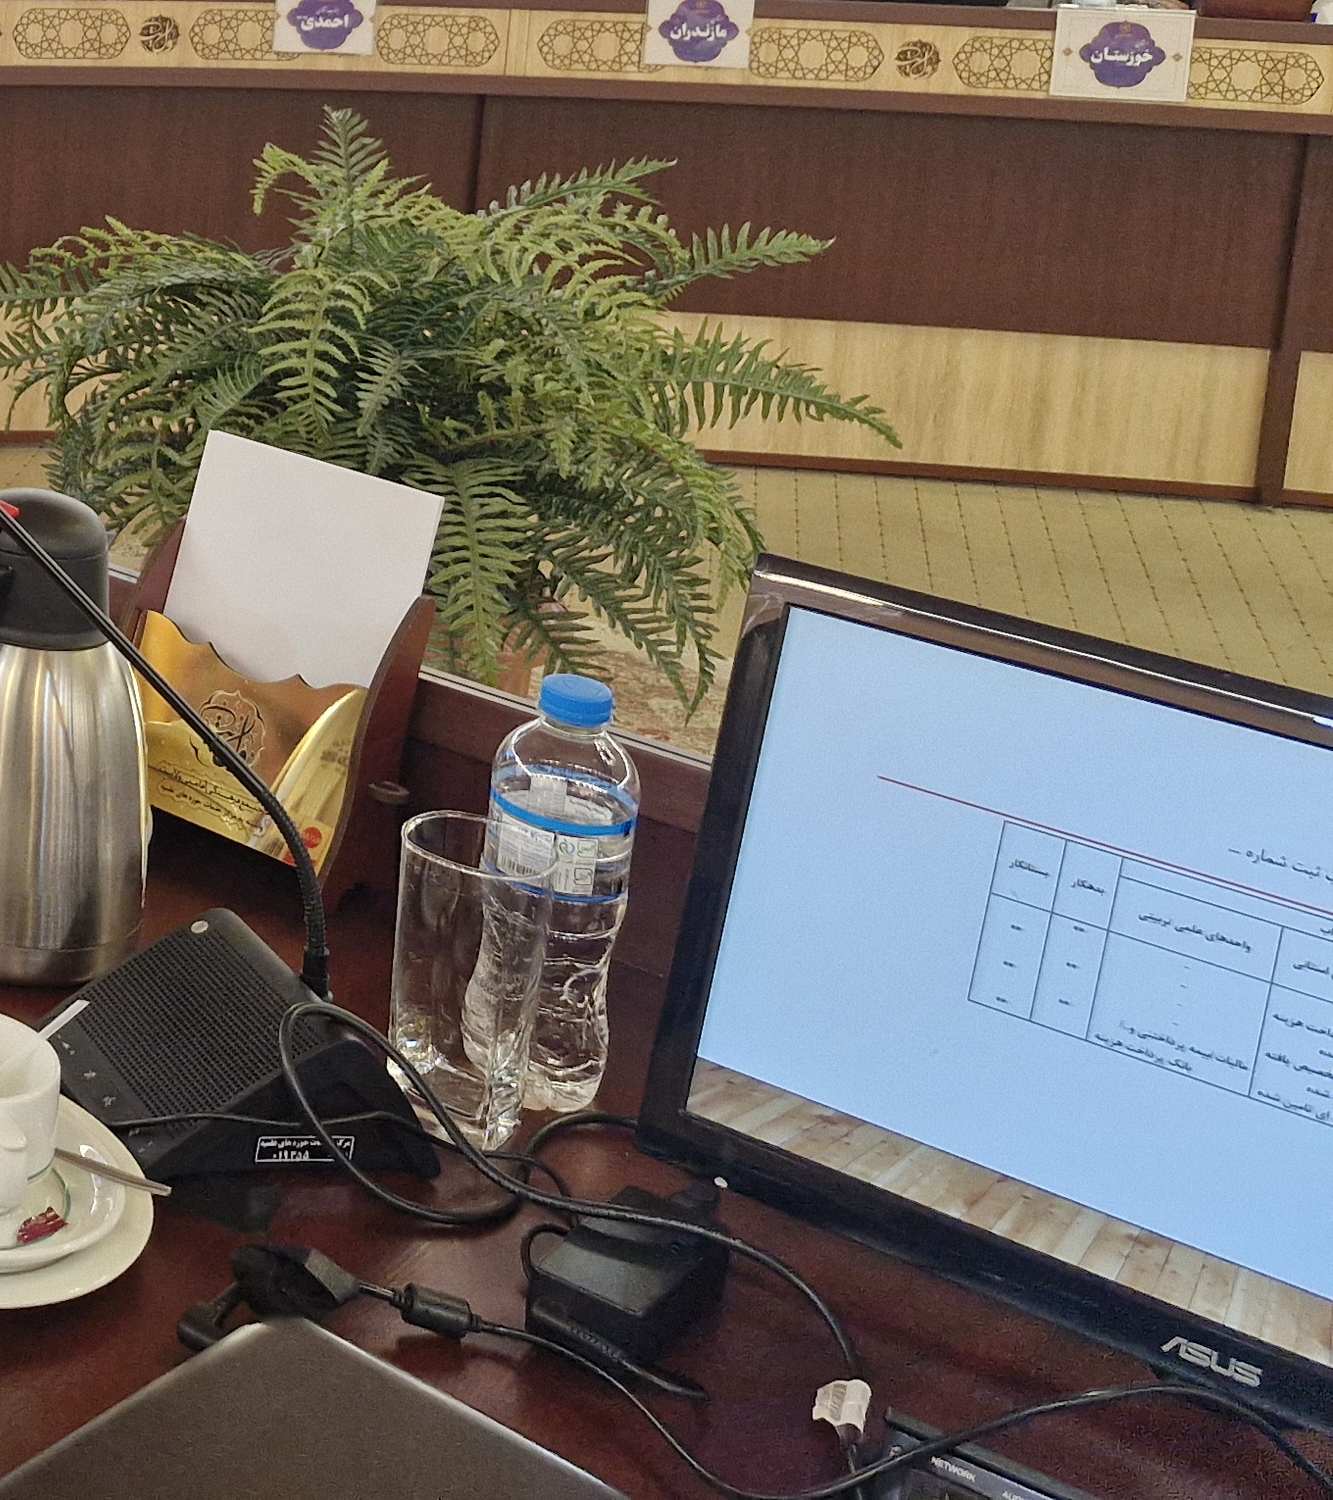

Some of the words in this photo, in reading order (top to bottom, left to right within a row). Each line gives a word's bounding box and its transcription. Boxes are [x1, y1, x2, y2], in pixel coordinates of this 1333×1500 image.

[300, 13, 350, 31] احمدی
[669, 21, 728, 42] مازندران
[1090, 46, 1154, 67] خوزستان
[1245, 848, 1288, 868] شماره
[1291, 862, 1321, 880] ثبت
[1174, 923, 1204, 936] علمی
[1094, 1032, 1124, 1049] هزینه
[1125, 1045, 1165, 1064] پرداخت
[1264, 1050, 1291, 1065] یافته
[1167, 1057, 1193, 1072] بانک
[1256, 1089, 1282, 1102] شده
[1160, 1335, 1264, 1388] ASUS
[930, 1455, 977, 1483] NETWORK
